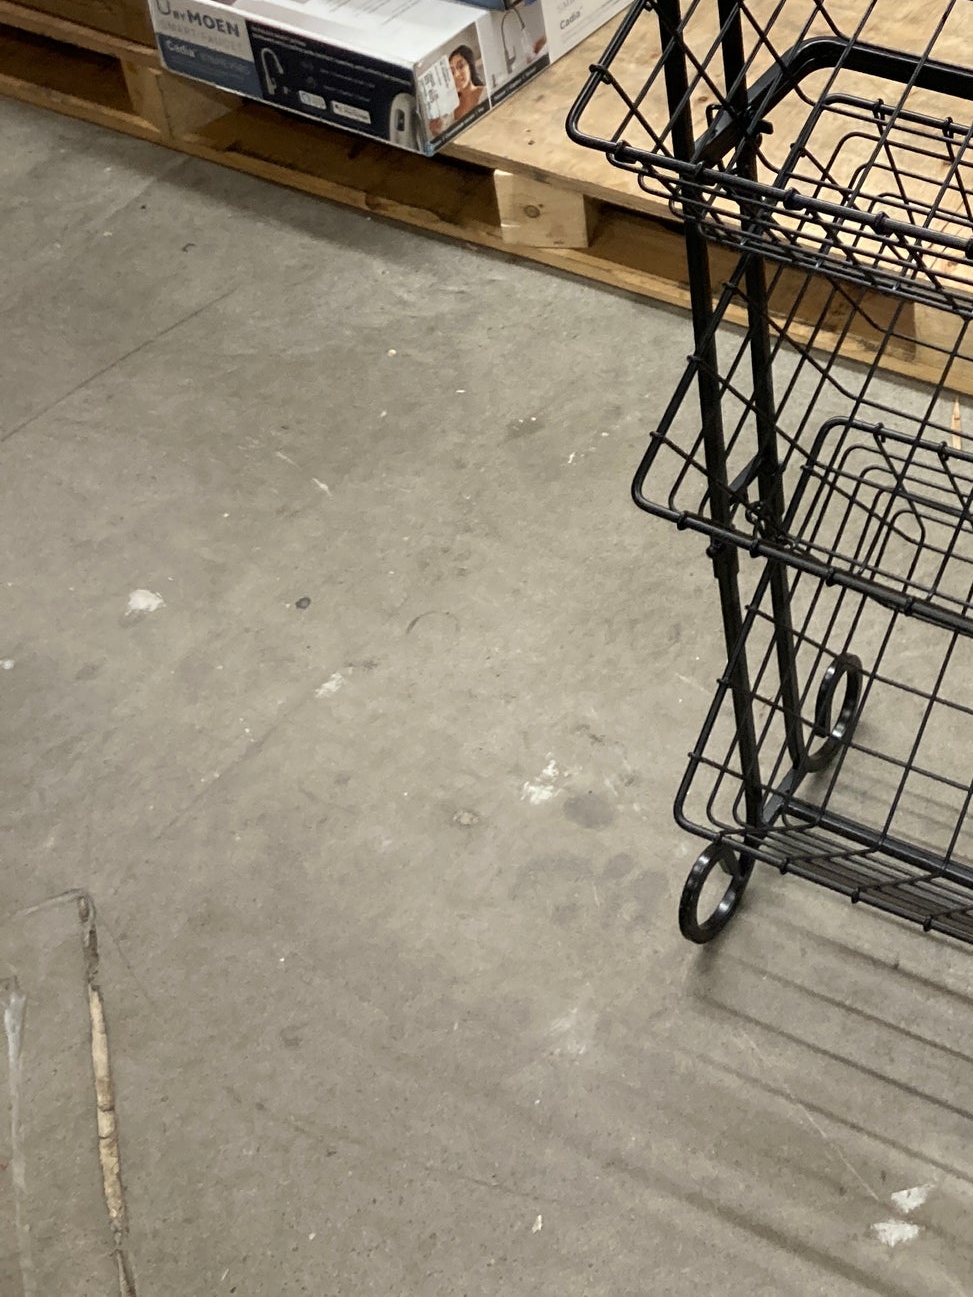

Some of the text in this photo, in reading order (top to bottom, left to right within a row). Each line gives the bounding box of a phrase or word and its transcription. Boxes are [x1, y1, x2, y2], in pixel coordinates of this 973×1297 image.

[187, 9, 241, 38] MOEN
[559, 10, 582, 30] Cadia
[165, 38, 196, 59] Cadia
